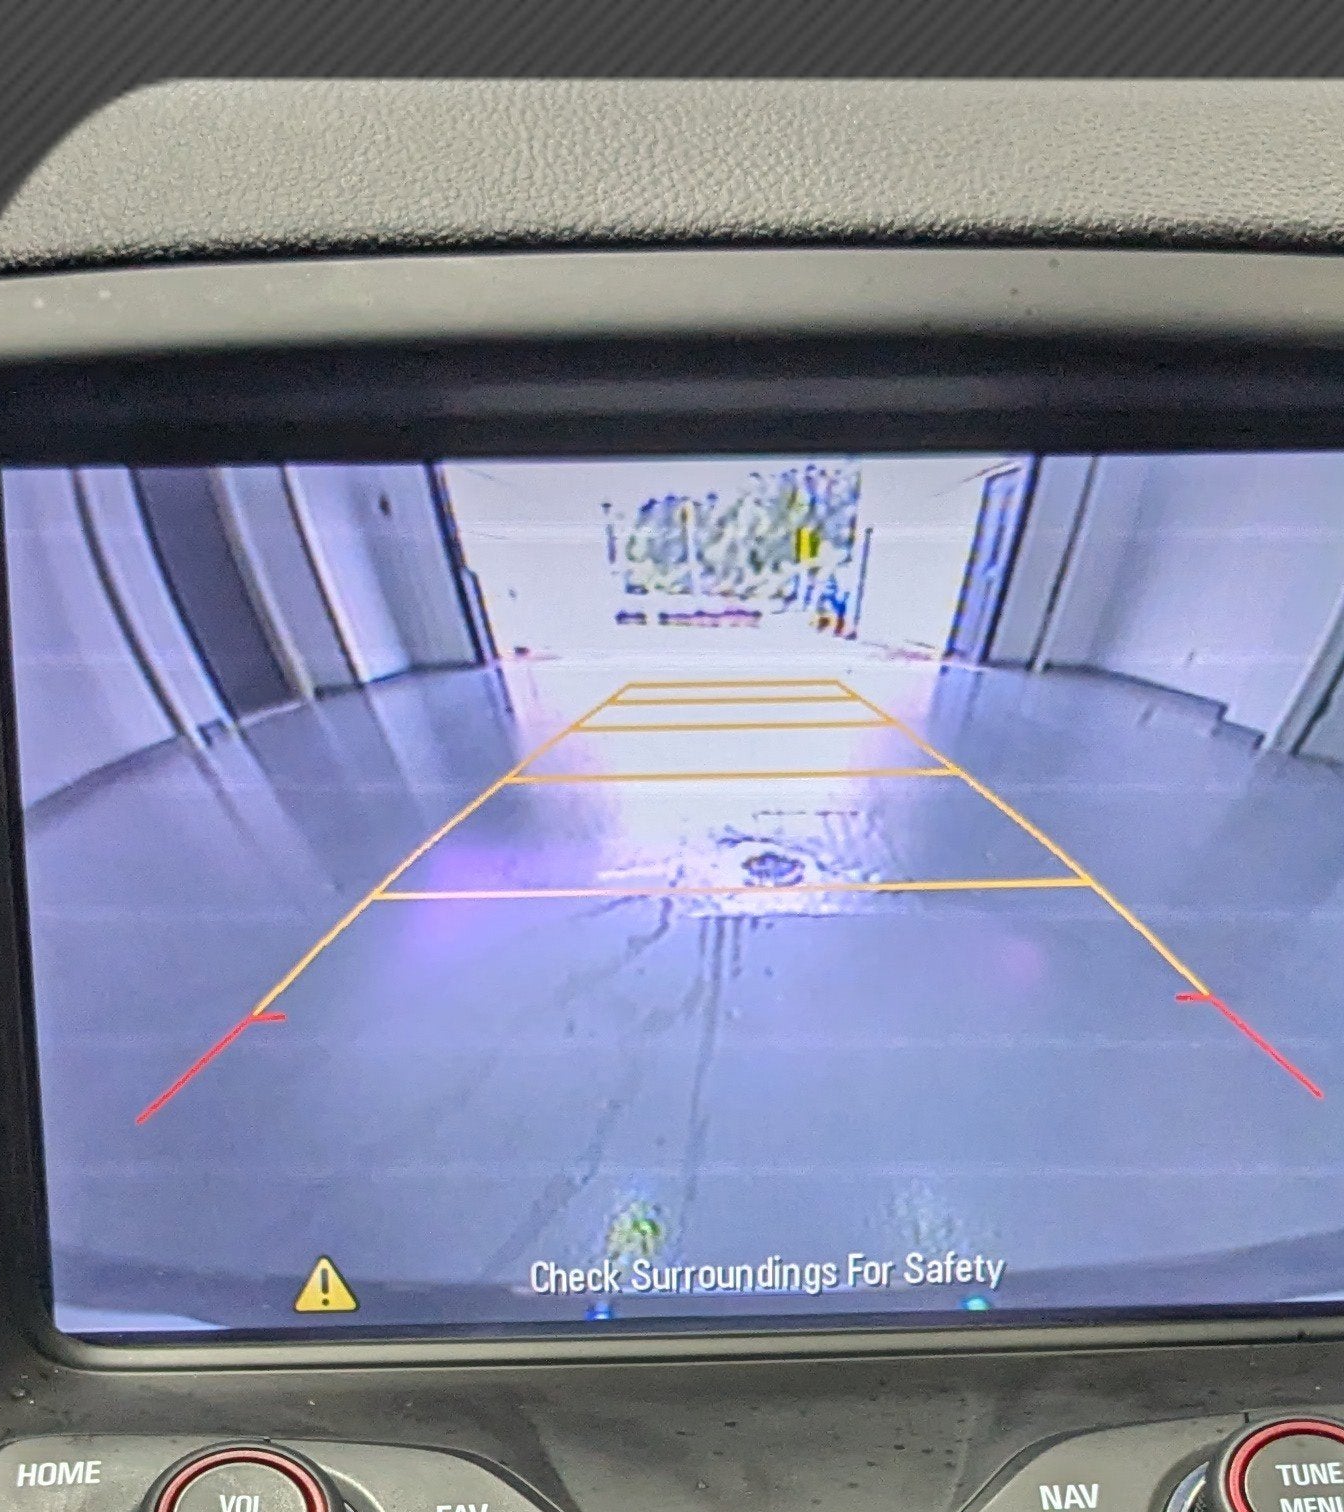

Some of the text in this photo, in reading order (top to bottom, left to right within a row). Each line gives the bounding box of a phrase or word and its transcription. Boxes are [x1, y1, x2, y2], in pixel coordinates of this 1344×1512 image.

[530, 1251, 1006, 1294] Check Surroundings For Safety
[16, 1460, 102, 1487] HOME
[1274, 1461, 1344, 1487] TUNE
[1039, 1483, 1099, 1511] NAV
